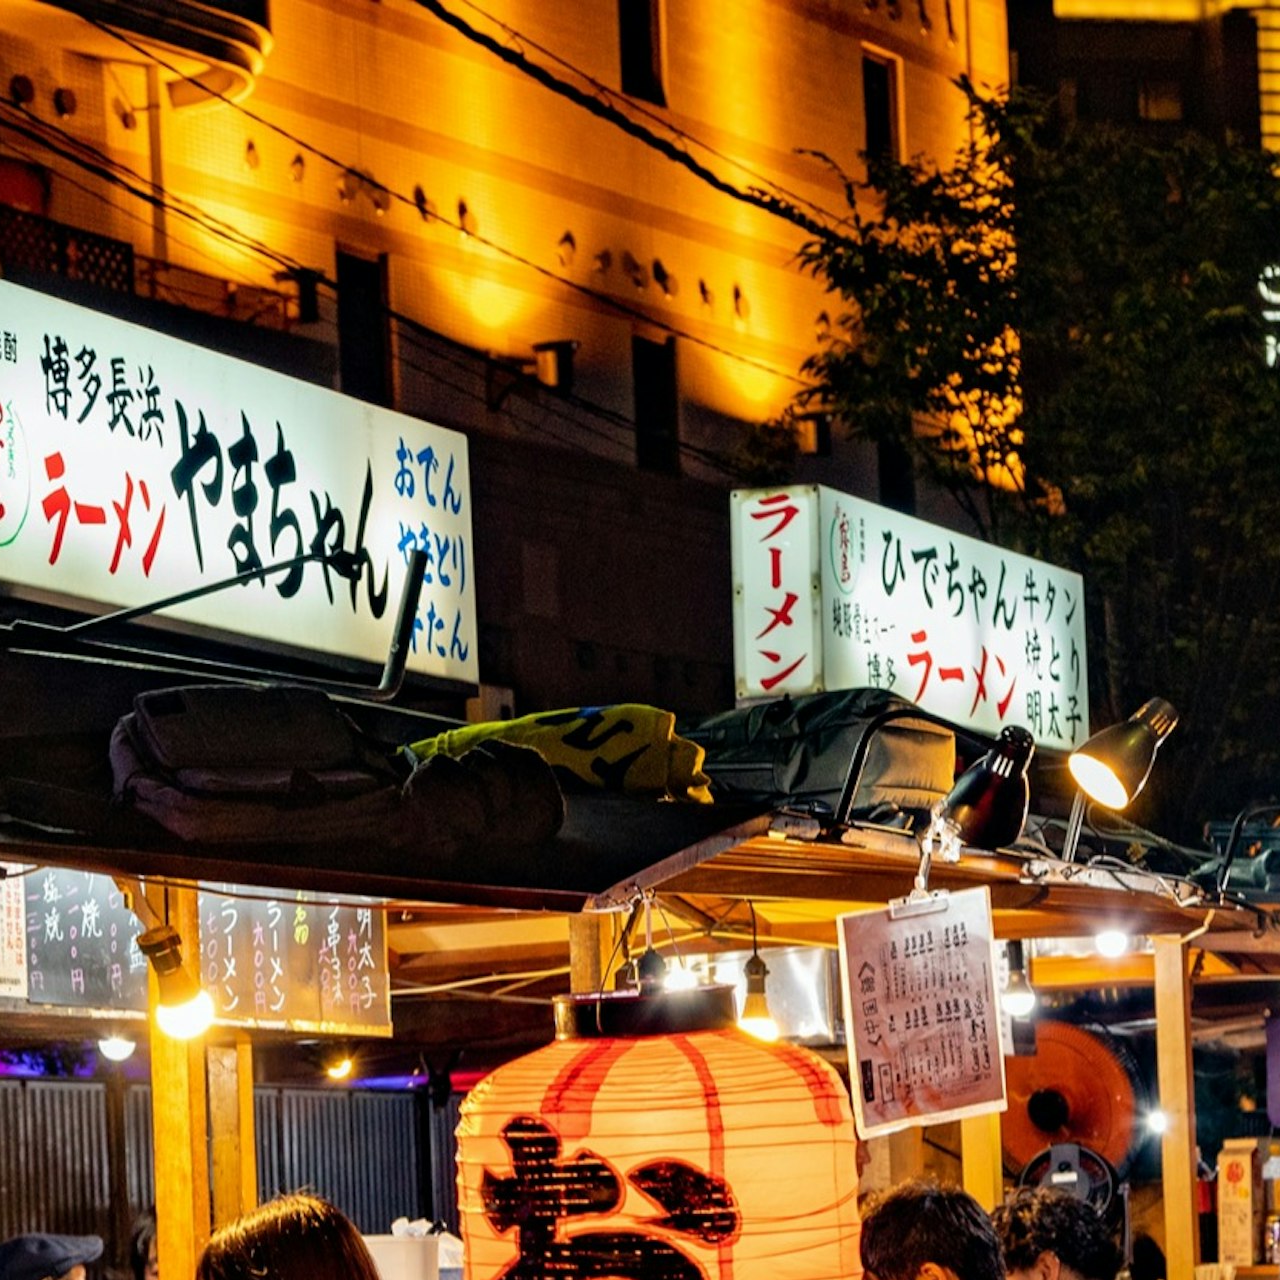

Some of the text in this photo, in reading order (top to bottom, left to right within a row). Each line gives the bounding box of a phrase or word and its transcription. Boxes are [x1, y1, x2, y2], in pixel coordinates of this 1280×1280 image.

[40, 333, 165, 448] 博多長浜
[40, 451, 168, 579] ラーメン
[170, 397, 390, 620] やまちゃん
[394, 435, 463, 516] おでん
[750, 493, 809, 691] ラーメン
[881, 530, 1018, 632] ひでちゃん
[1022, 568, 1077, 625] 牛タン
[866, 653, 897, 691] 博多
[906, 629, 1018, 723] ラーメン
[1024, 629, 1080, 689] 焼とり
[1025, 690, 1083, 744] 明太子
